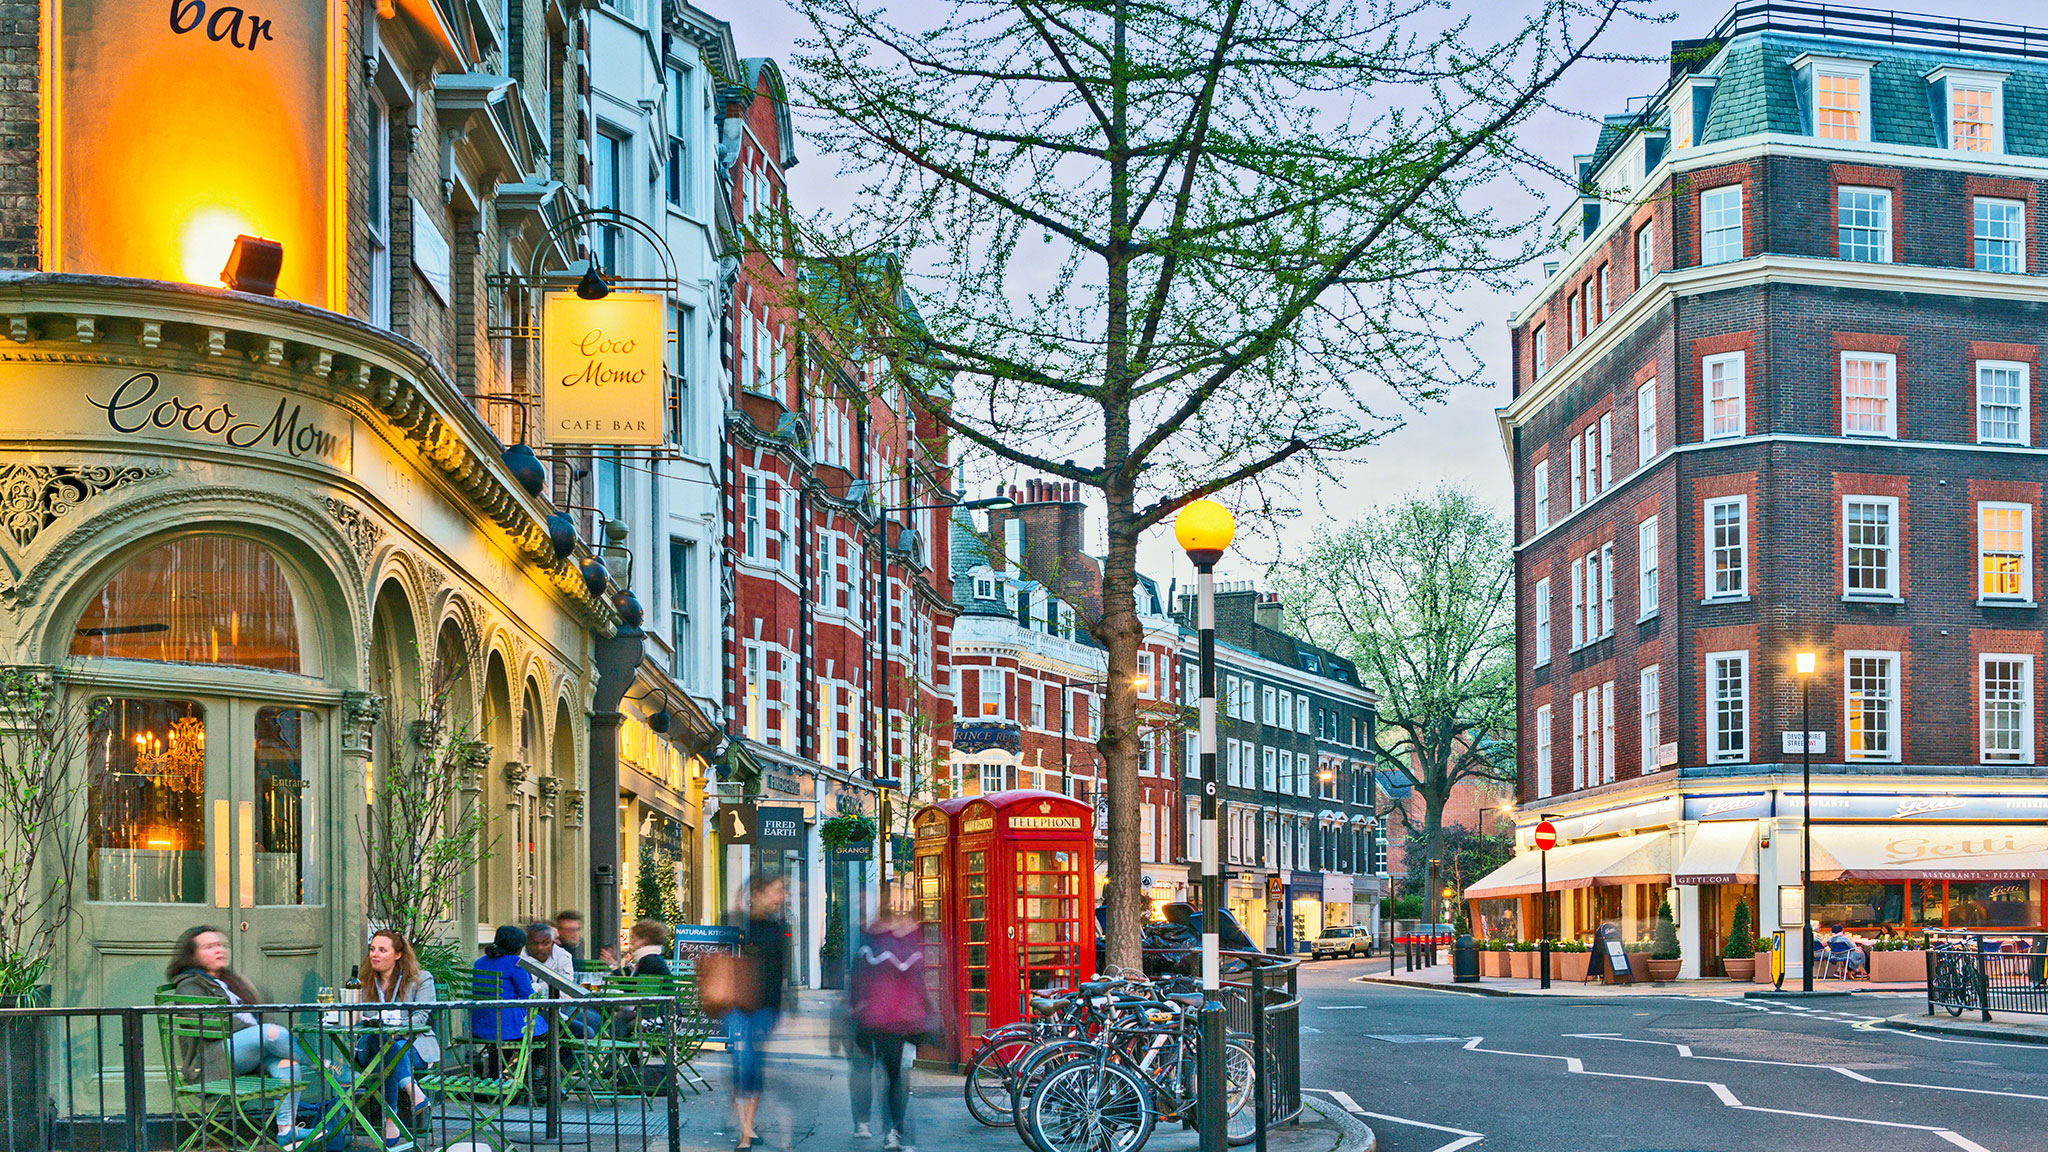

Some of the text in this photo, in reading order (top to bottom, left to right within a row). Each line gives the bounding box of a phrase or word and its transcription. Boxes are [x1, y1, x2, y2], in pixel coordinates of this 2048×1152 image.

[169, 0, 274, 52] bar
[570, 328, 638, 357] Coco
[561, 359, 648, 388] Momo
[85, 371, 351, 464] Coco Momo
[560, 419, 647, 431] CAFE BAR
[955, 731, 991, 741] RINCE
[271, 774, 311, 789] Entrance
[1205, 781, 1217, 796] 6
[765, 820, 796, 829] FIRED
[1012, 818, 1078, 828] TELEPHONE
[763, 828, 797, 836] EARTH
[1884, 835, 2030, 865] Getti
[1678, 876, 1730, 884] GETTI.COM
[675, 928, 708, 937] NATURAL
